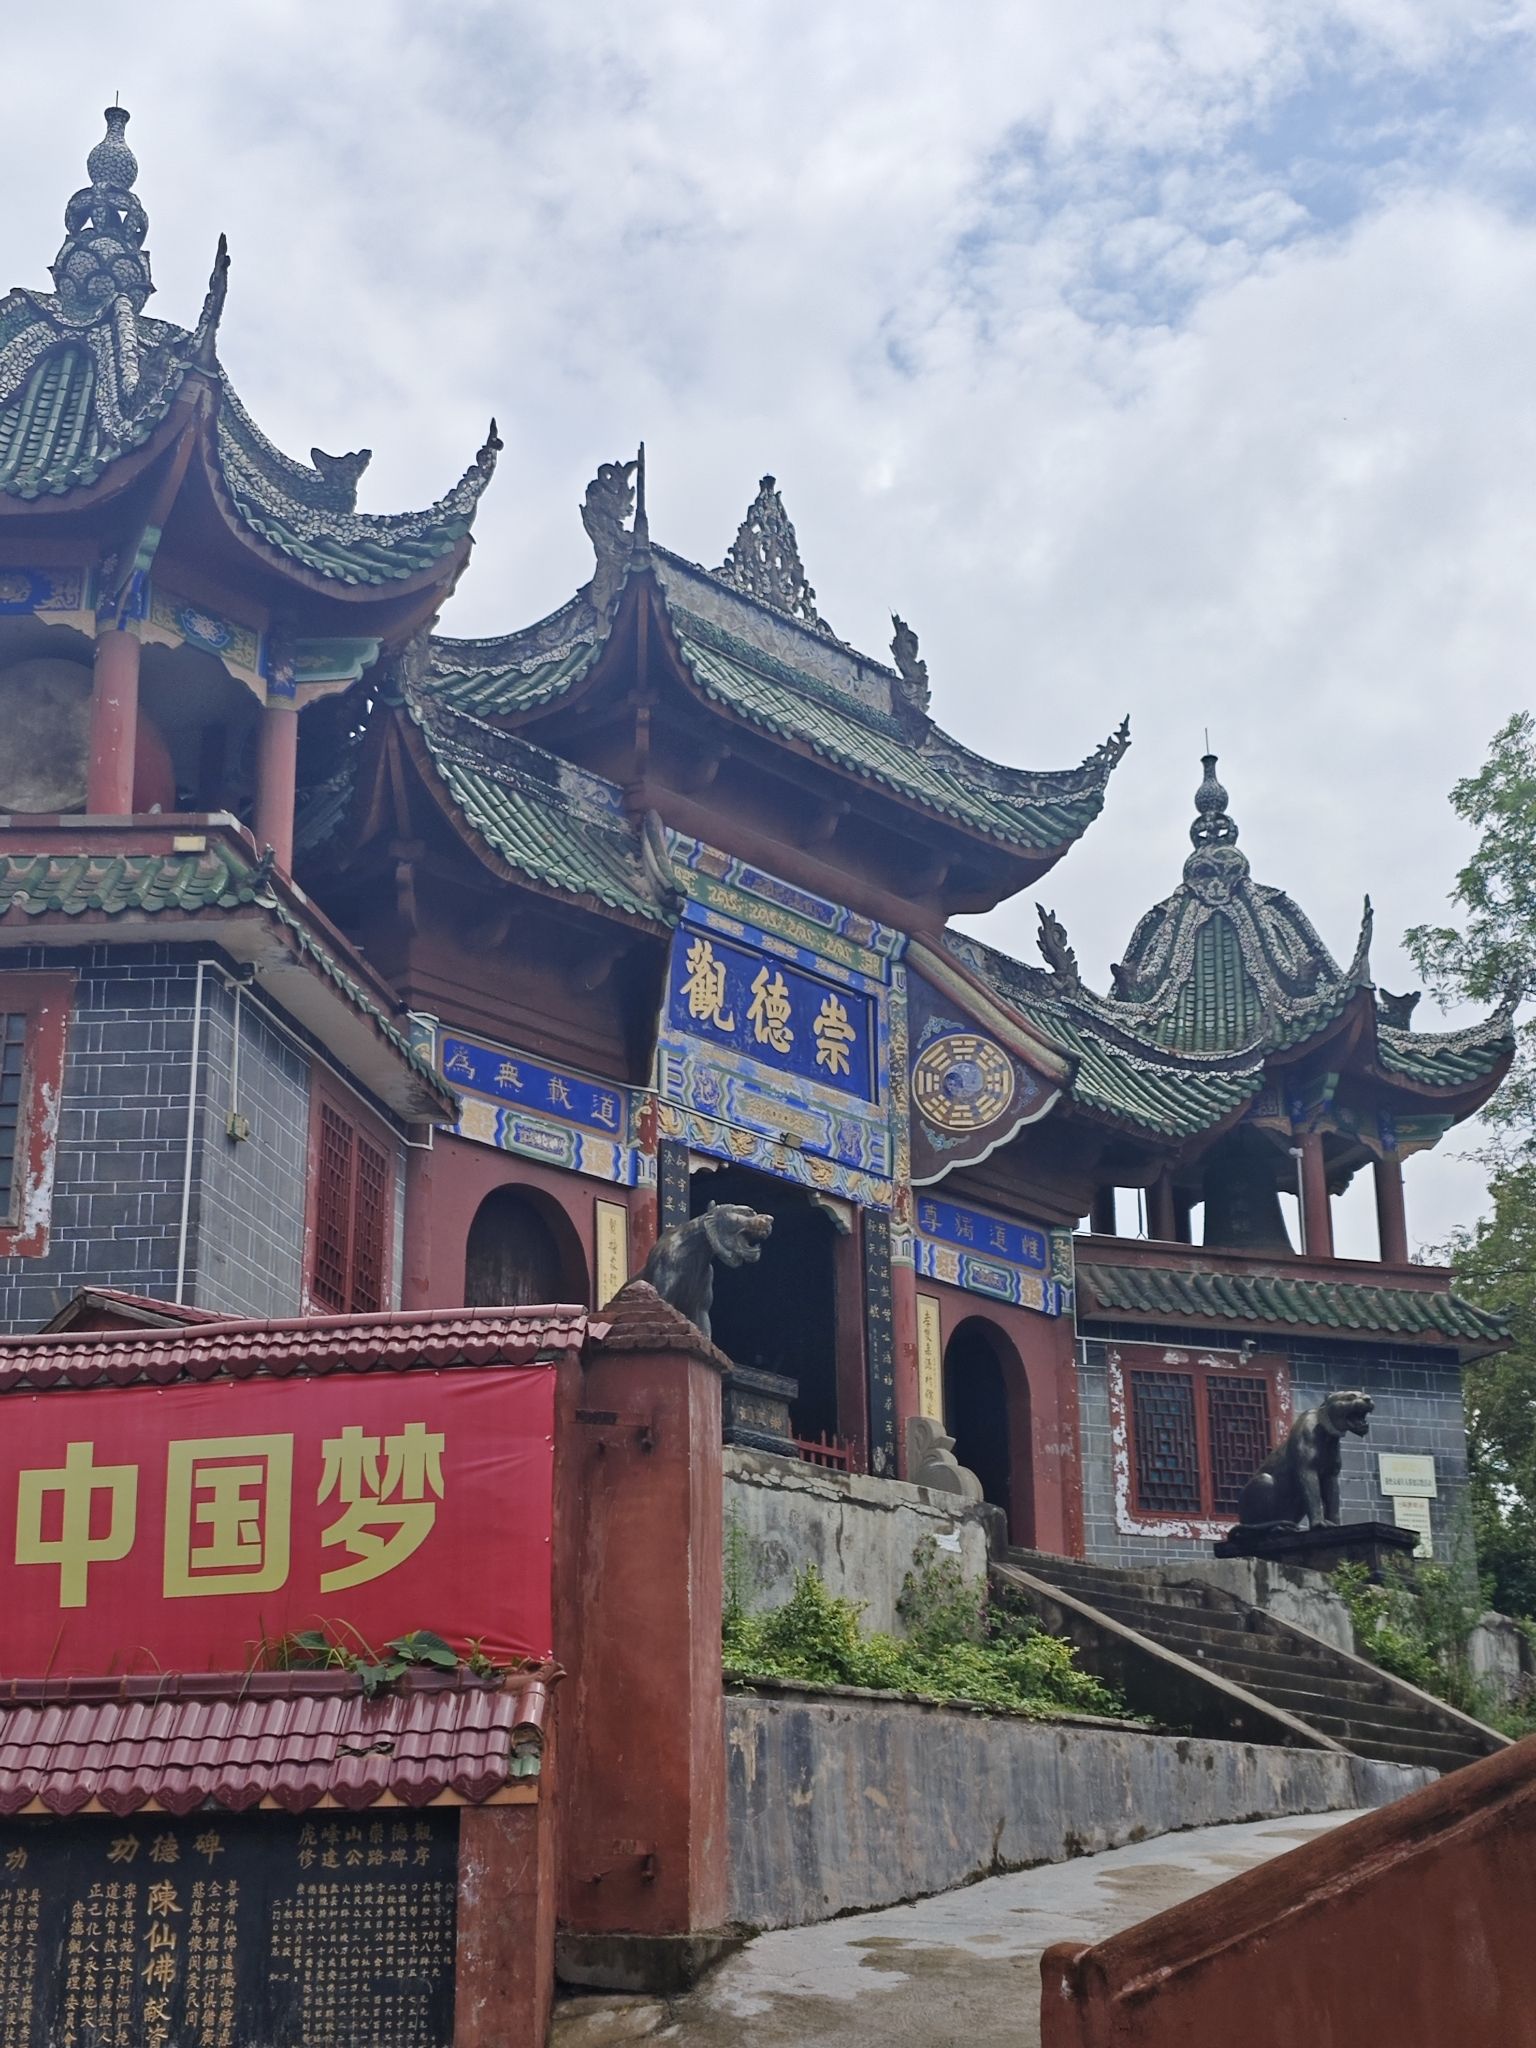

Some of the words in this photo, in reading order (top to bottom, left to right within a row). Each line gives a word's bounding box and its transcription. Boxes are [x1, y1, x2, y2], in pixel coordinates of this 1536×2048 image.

[15, 1422, 445, 1609] 中国梦
[106, 1830, 226, 1865] 功德碑
